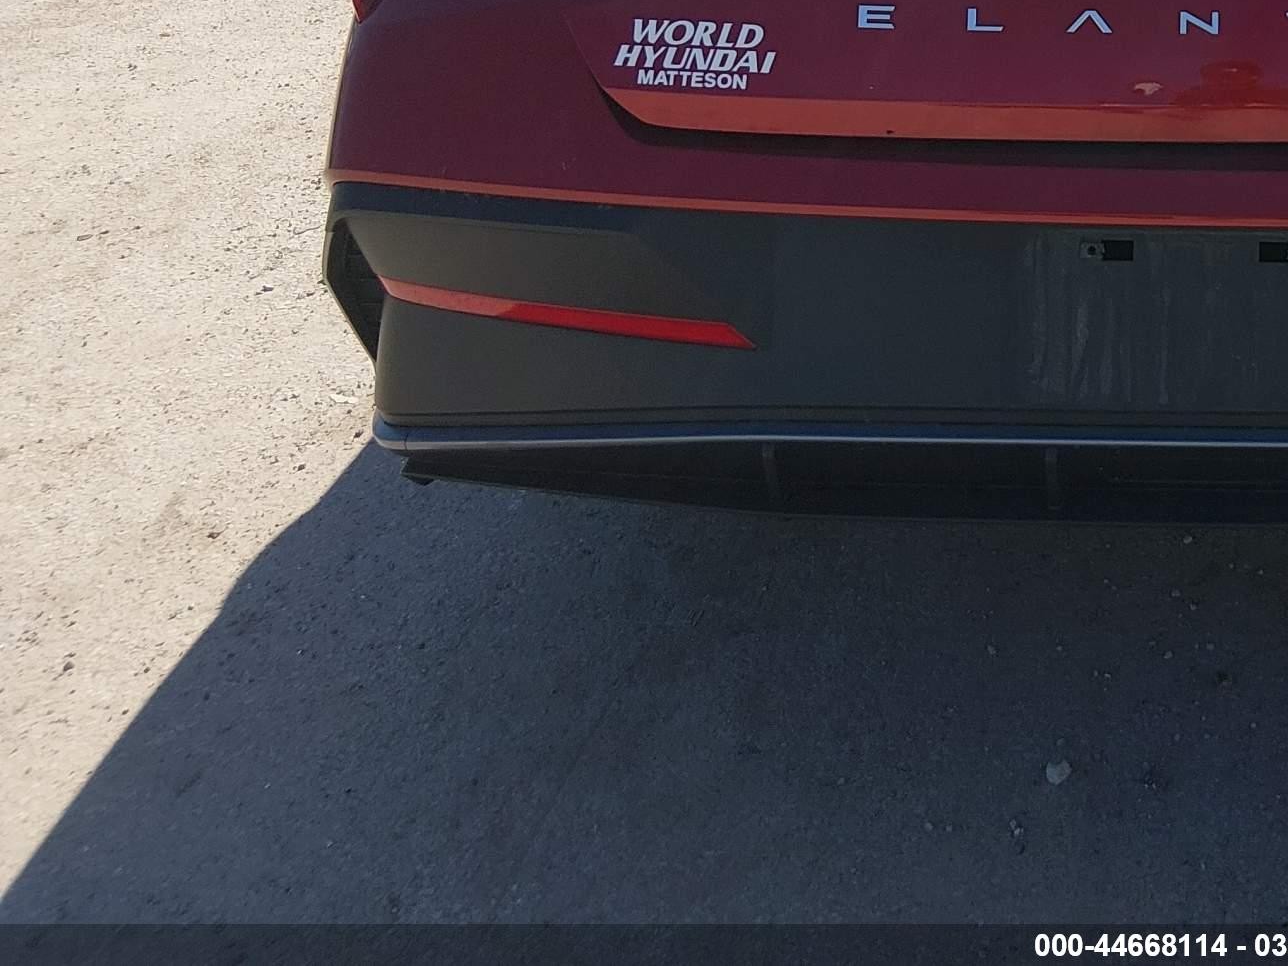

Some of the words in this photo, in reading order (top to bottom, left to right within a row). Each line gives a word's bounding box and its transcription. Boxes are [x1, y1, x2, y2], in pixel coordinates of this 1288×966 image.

[632, 17, 765, 49] WORLD
[612, 43, 777, 74] HYUNDAI
[636, 68, 749, 91] MATTESON
